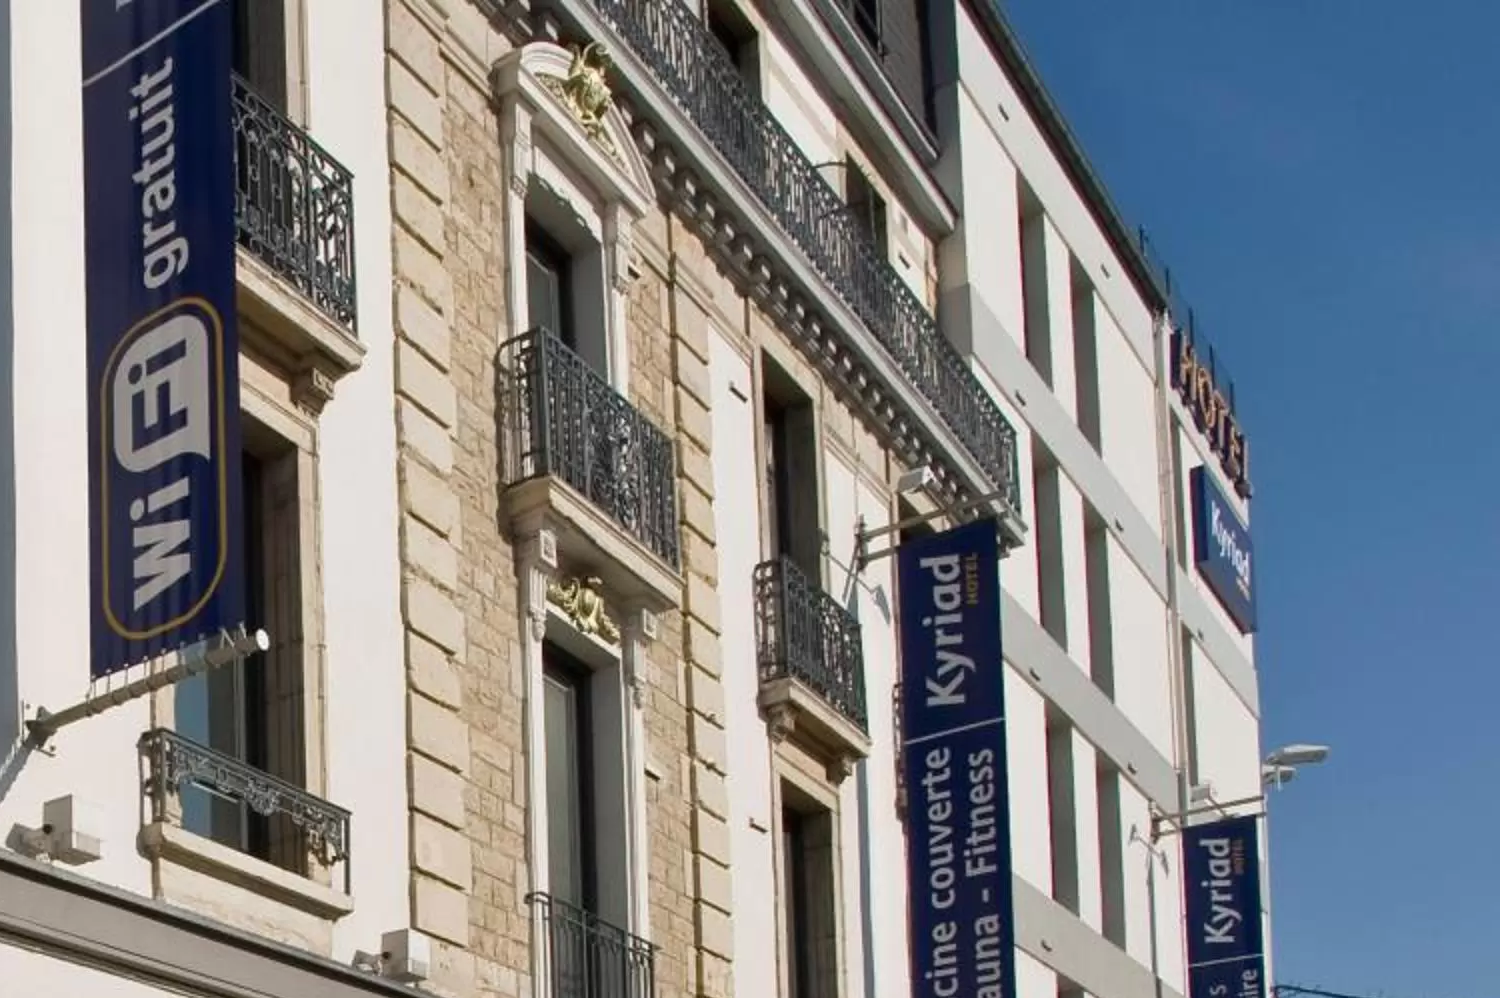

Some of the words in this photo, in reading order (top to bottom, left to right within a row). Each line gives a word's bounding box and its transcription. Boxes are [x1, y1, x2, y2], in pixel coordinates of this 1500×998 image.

[128, 56, 189, 289] gratuit
[965, 552, 980, 605] HOTEL
[1211, 499, 1250, 580] Kyriad
[919, 553, 976, 707] Kyriad
[925, 746, 956, 907] couverte
[964, 747, 998, 877] Fitness
[1199, 838, 1243, 944] Kyriad
